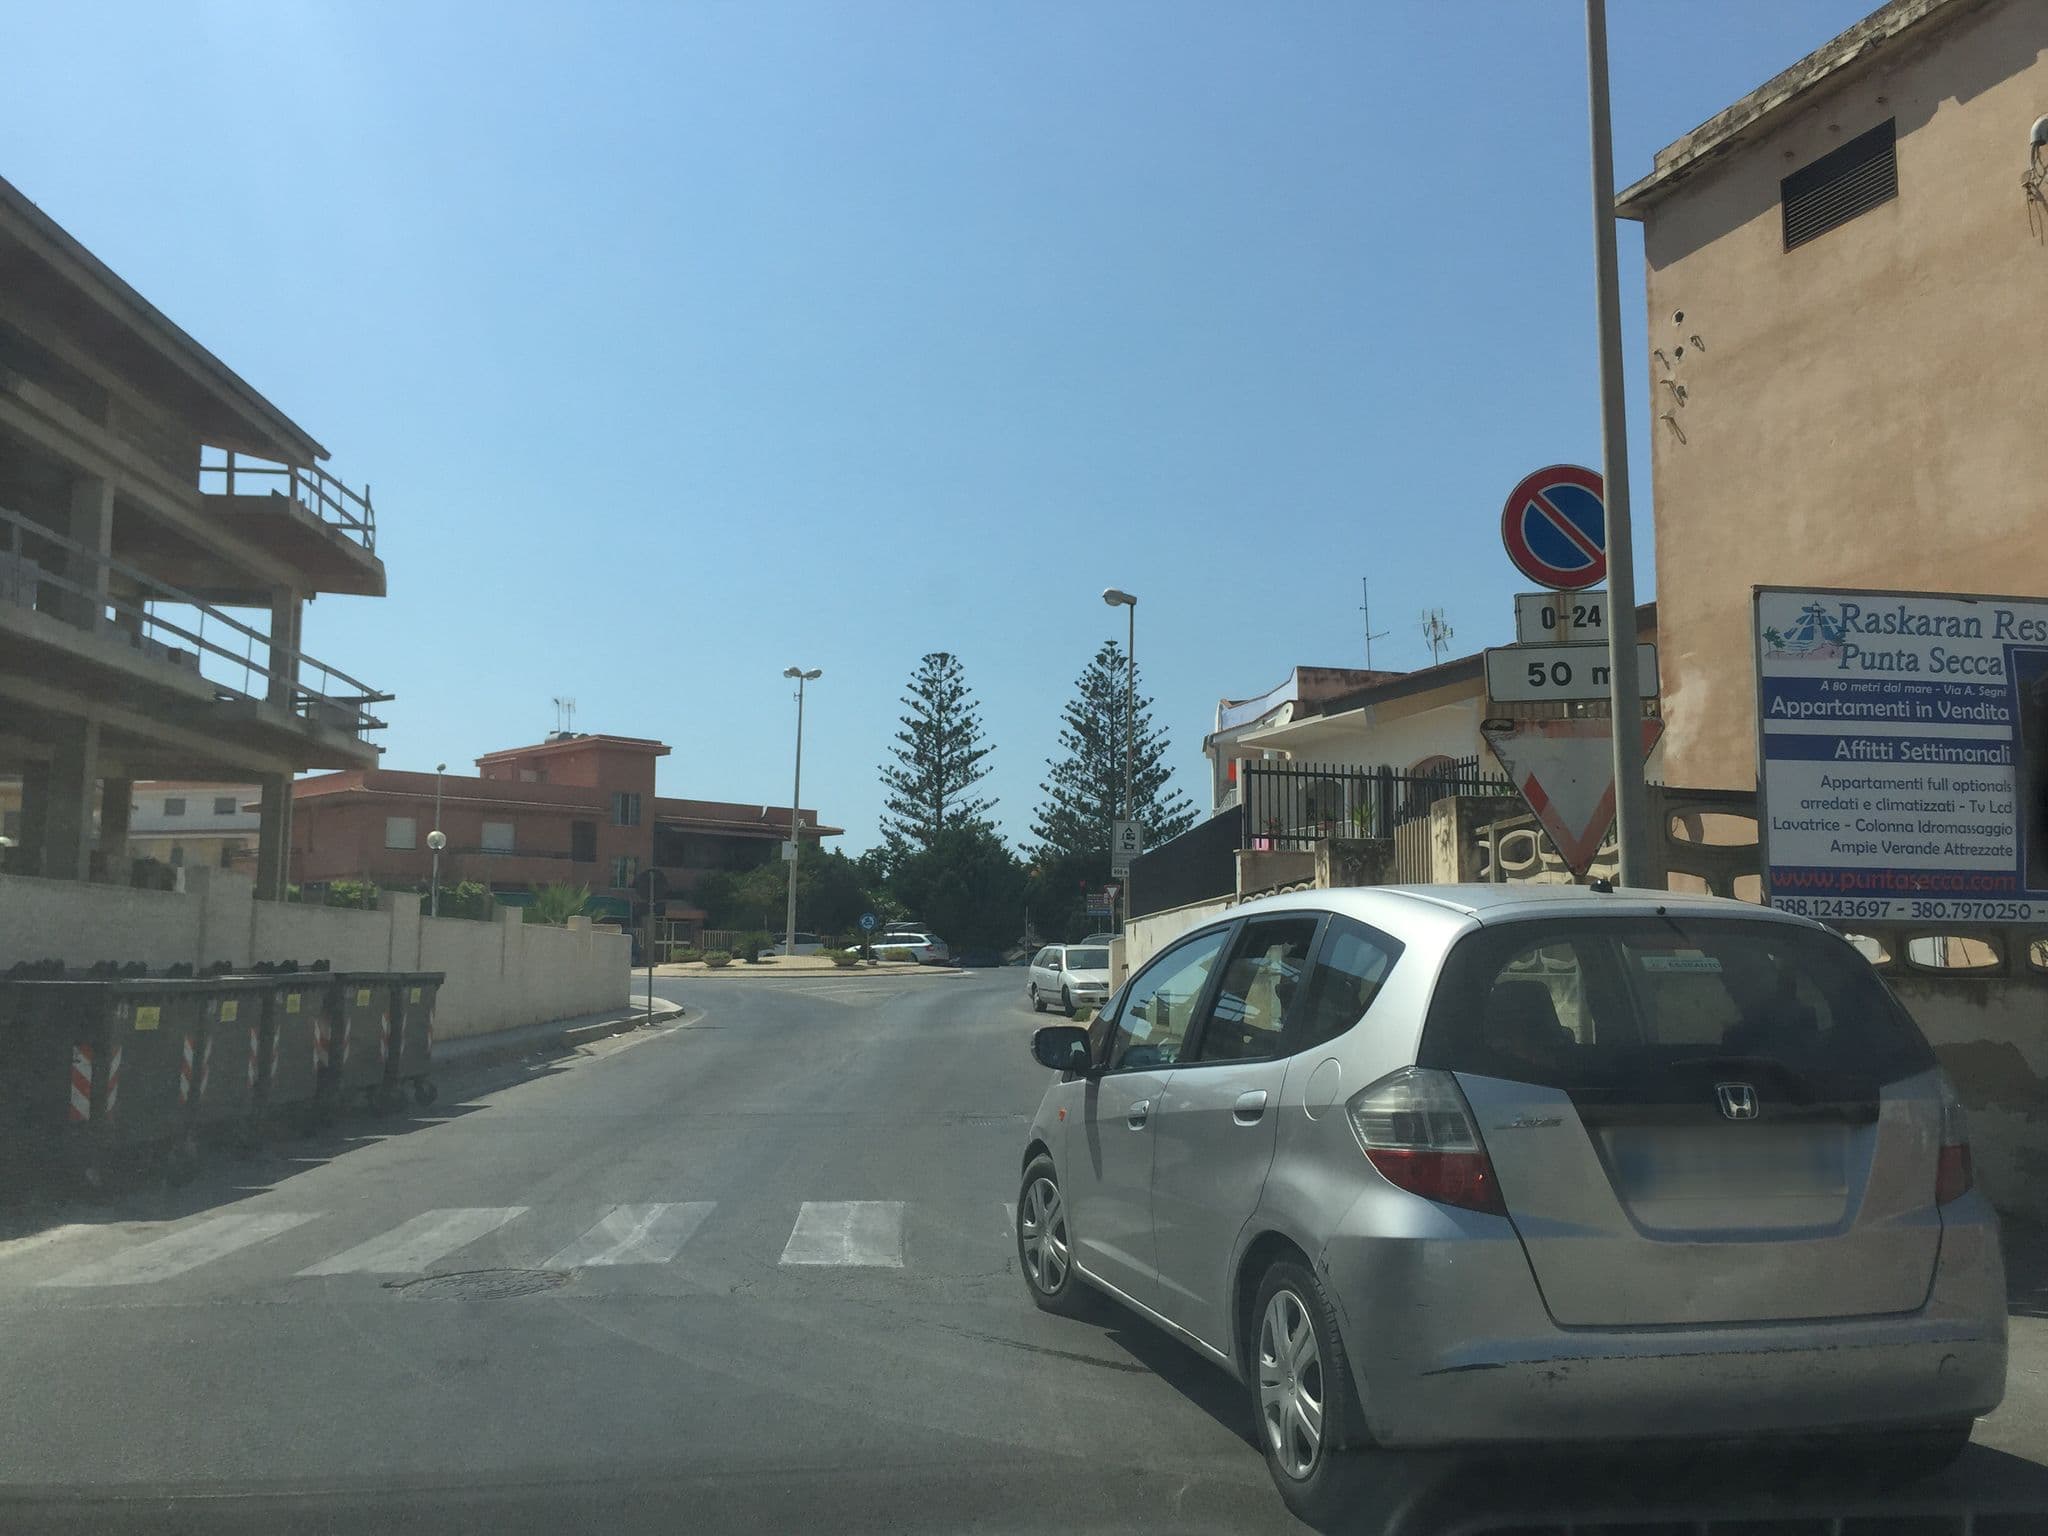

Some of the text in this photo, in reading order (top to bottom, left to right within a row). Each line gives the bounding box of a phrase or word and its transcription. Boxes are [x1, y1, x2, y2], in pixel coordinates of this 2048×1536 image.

[1839, 603, 2047, 642] Raskaran Res
[1838, 643, 2004, 676] Punta Secca
[1528, 661, 1572, 687] 50
[1820, 680, 1830, 691] A
[1833, 682, 1847, 692] 80
[1850, 683, 1881, 692] metri
[1883, 683, 1901, 693] dal
[1904, 685, 1933, 694] mare
[1944, 685, 1962, 695] Via
[1978, 687, 2007, 697] Segni
[1771, 695, 2010, 721] Appartamenti in Vendita
[1834, 740, 2011, 763] Affitti Settimanali
[1820, 775, 2012, 794] Appartamenti full optionals
[1801, 796, 1859, 810] arredati
[1863, 801, 1872, 811] e
[1875, 798, 1955, 813] climatizzati
[1968, 800, 1986, 813] Tv
[1989, 800, 2013, 814] Lcd
[1773, 816, 1840, 832] Lavatrice
[1856, 818, 1914, 833] Colonna
[1918, 820, 2013, 837] Idromassaggio
[1830, 839, 2013, 857] Ampie Verande Attrezzate
[1771, 869, 2016, 892] www.puntasecca.com
[1911, 902, 2031, 920] 380.7970250
